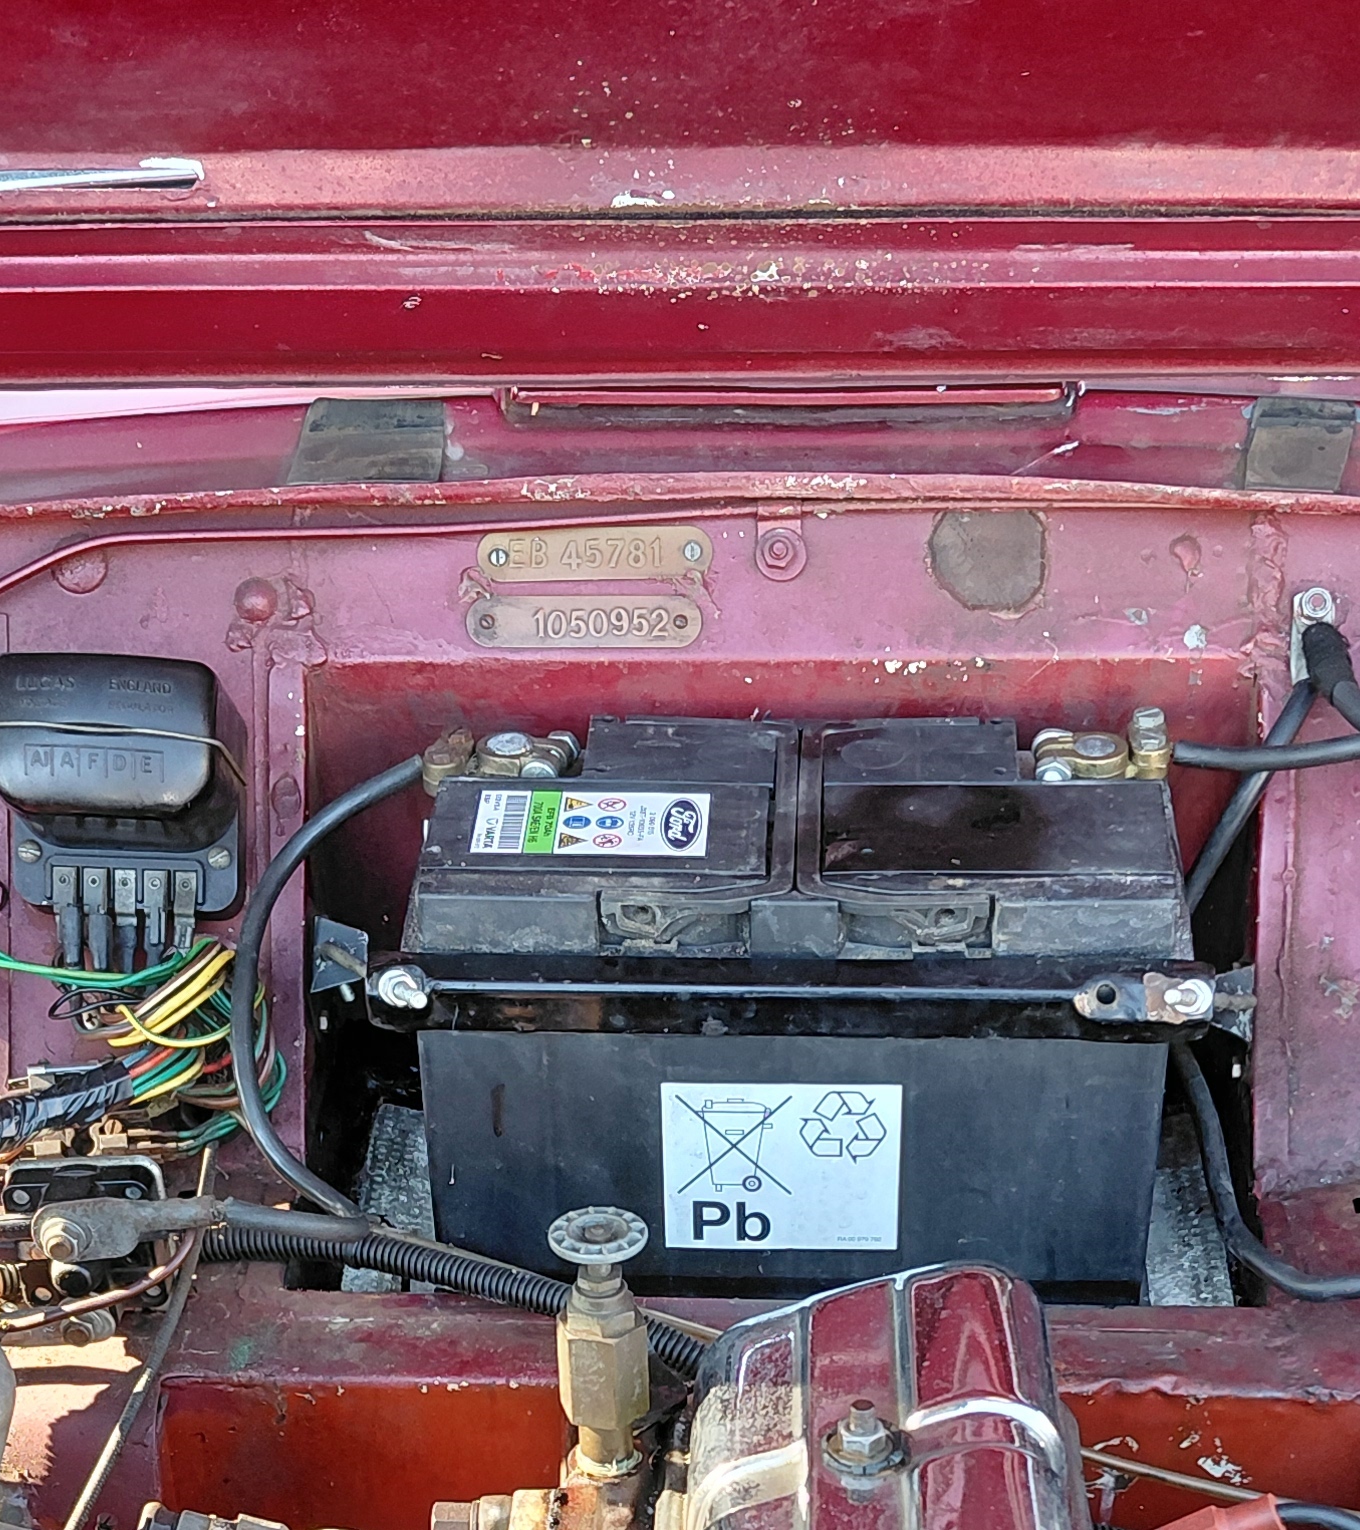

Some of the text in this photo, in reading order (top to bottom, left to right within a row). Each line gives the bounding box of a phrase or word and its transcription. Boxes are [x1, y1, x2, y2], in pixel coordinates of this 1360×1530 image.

[507, 536, 662, 570] EB 45781
[532, 608, 670, 639] 1050952
[15, 675, 172, 695] LUCAS ENGLAND
[60, 751, 74, 769] A
[88, 752, 99, 770] F
[112, 754, 127, 771] D
[141, 755, 152, 773] E
[482, 826, 496, 849] VARTA
[667, 807, 697, 842] Ford
[692, 1200, 771, 1242] Pb
